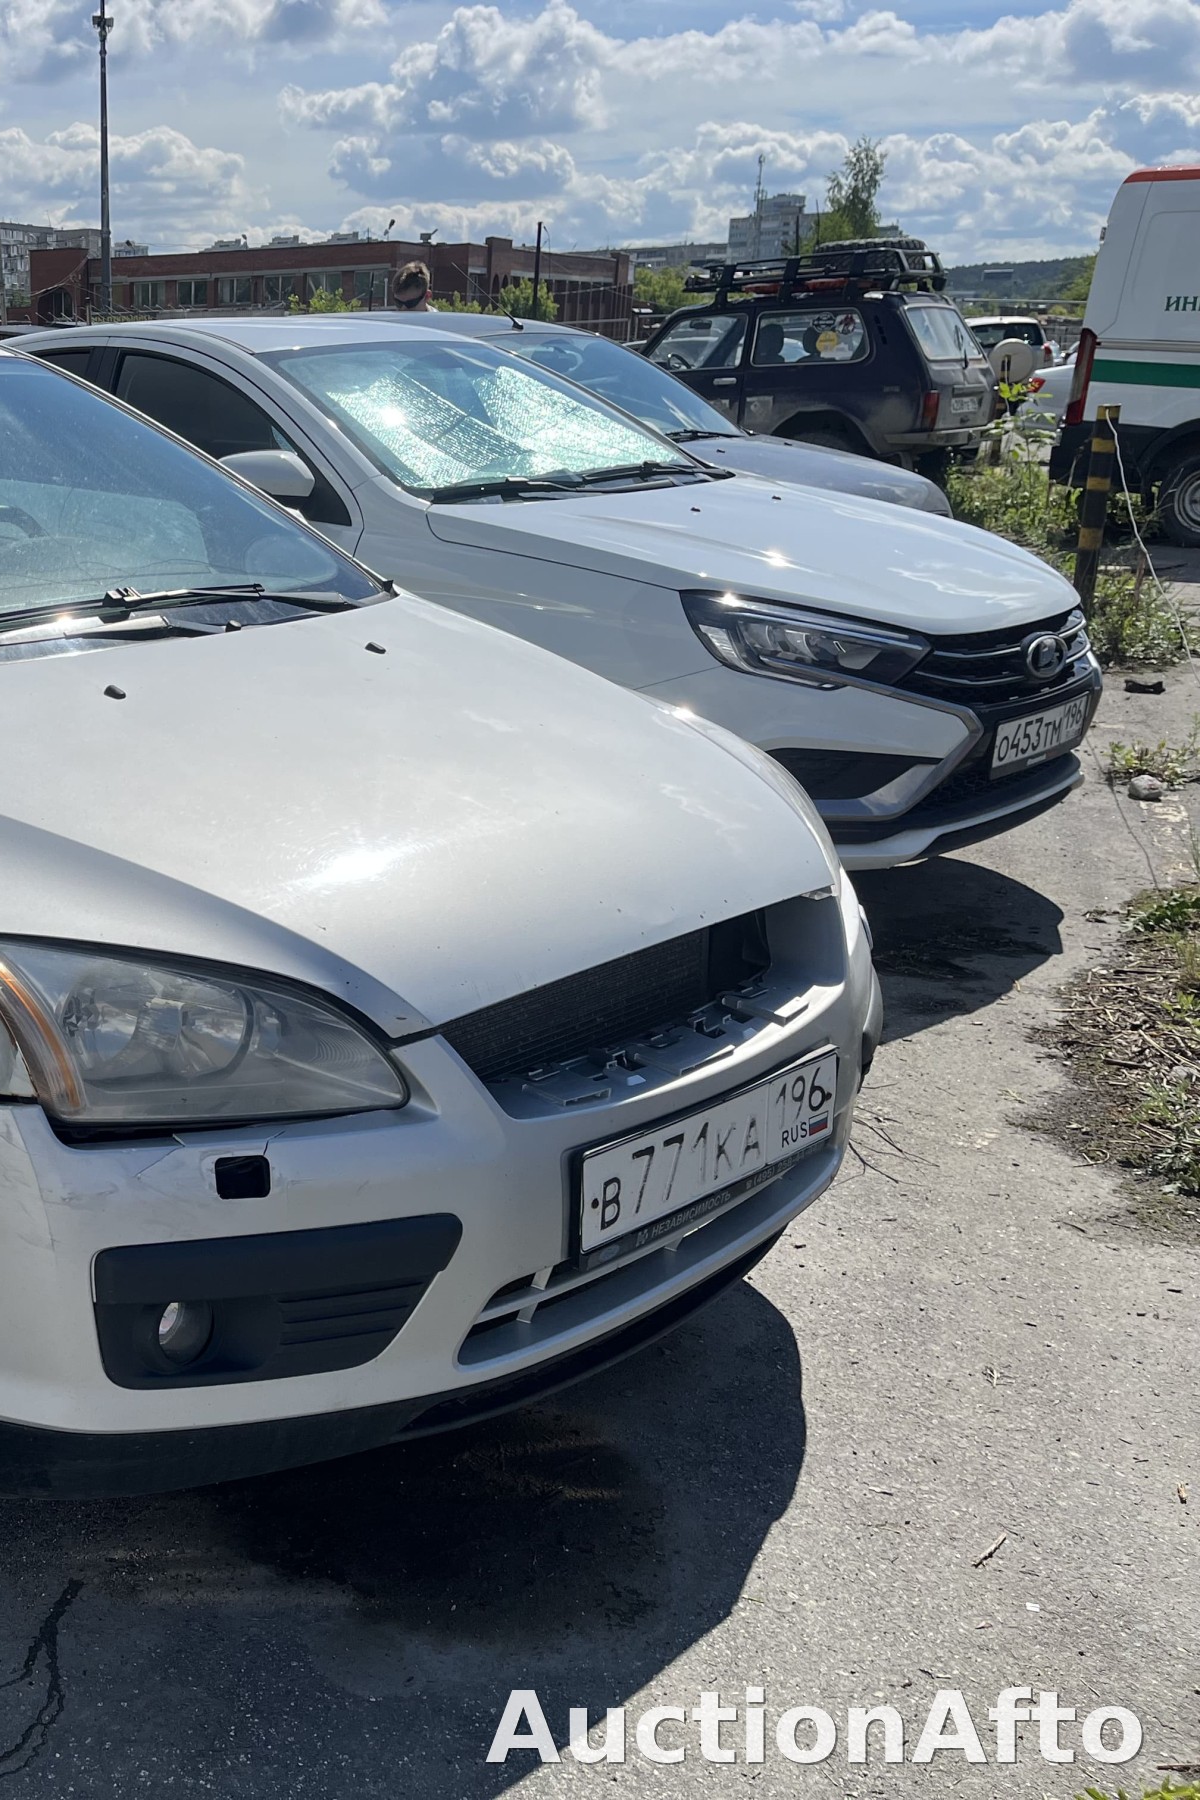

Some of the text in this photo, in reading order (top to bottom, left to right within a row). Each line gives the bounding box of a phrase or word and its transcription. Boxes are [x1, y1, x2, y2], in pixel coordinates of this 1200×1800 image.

[775, 1066, 826, 1130] 196
[781, 1121, 808, 1149] RUS
[650, 1190, 732, 1239] НЕЗАВИСИМОСТЬ
